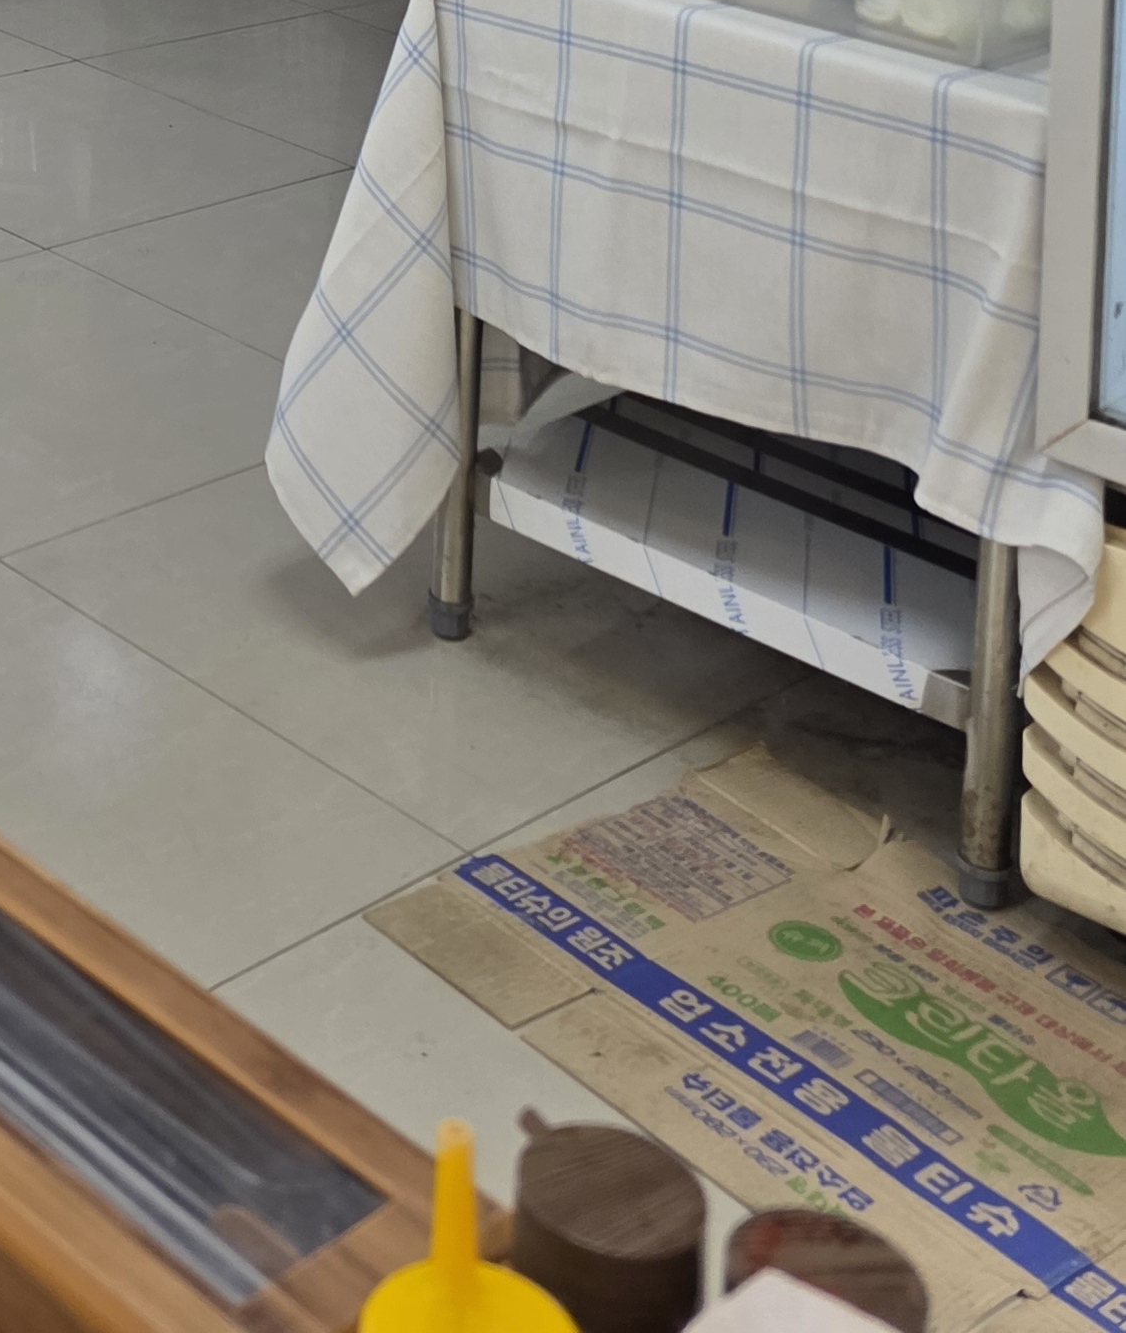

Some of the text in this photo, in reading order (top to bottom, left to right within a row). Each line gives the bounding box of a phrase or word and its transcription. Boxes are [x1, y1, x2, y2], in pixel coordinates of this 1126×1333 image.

[471, 861, 582, 933] 물티슈의
[567, 926, 634, 971] 원조
[658, 989, 850, 1116] 업소전용
[861, 1123, 1021, 1238] 물티슈
